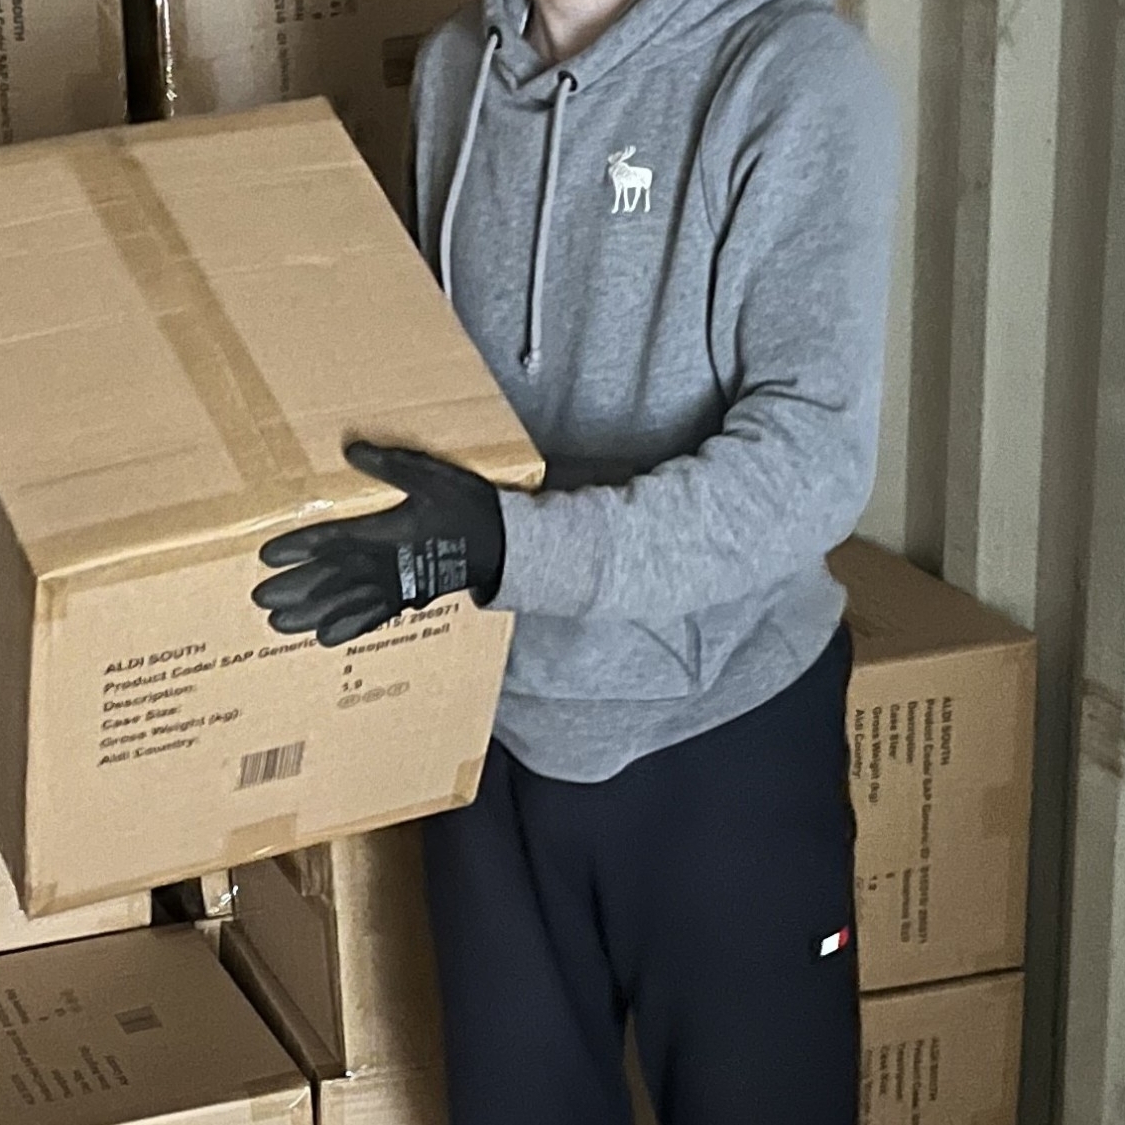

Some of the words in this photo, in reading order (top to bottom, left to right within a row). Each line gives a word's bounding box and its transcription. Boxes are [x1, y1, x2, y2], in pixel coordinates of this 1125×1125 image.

[103, 672, 166, 694] Product
[171, 660, 216, 678] Code/
[220, 650, 253, 666] SAP
[258, 638, 317, 658] Generic
[103, 684, 197, 711] Description:
[346, 634, 417, 656] Neoprene
[422, 623, 450, 638] Ball
[104, 658, 144, 675] ALDI
[148, 642, 206, 665] SOUTH
[102, 715, 140, 731] Case
[941, 697, 951, 723] ALDI
[99, 731, 147, 749] Gross
[151, 717, 205, 735] Weight
[940, 726, 951, 765] SOUTH
[97, 751, 129, 767] Aldi
[133, 737, 199, 758] Country:
